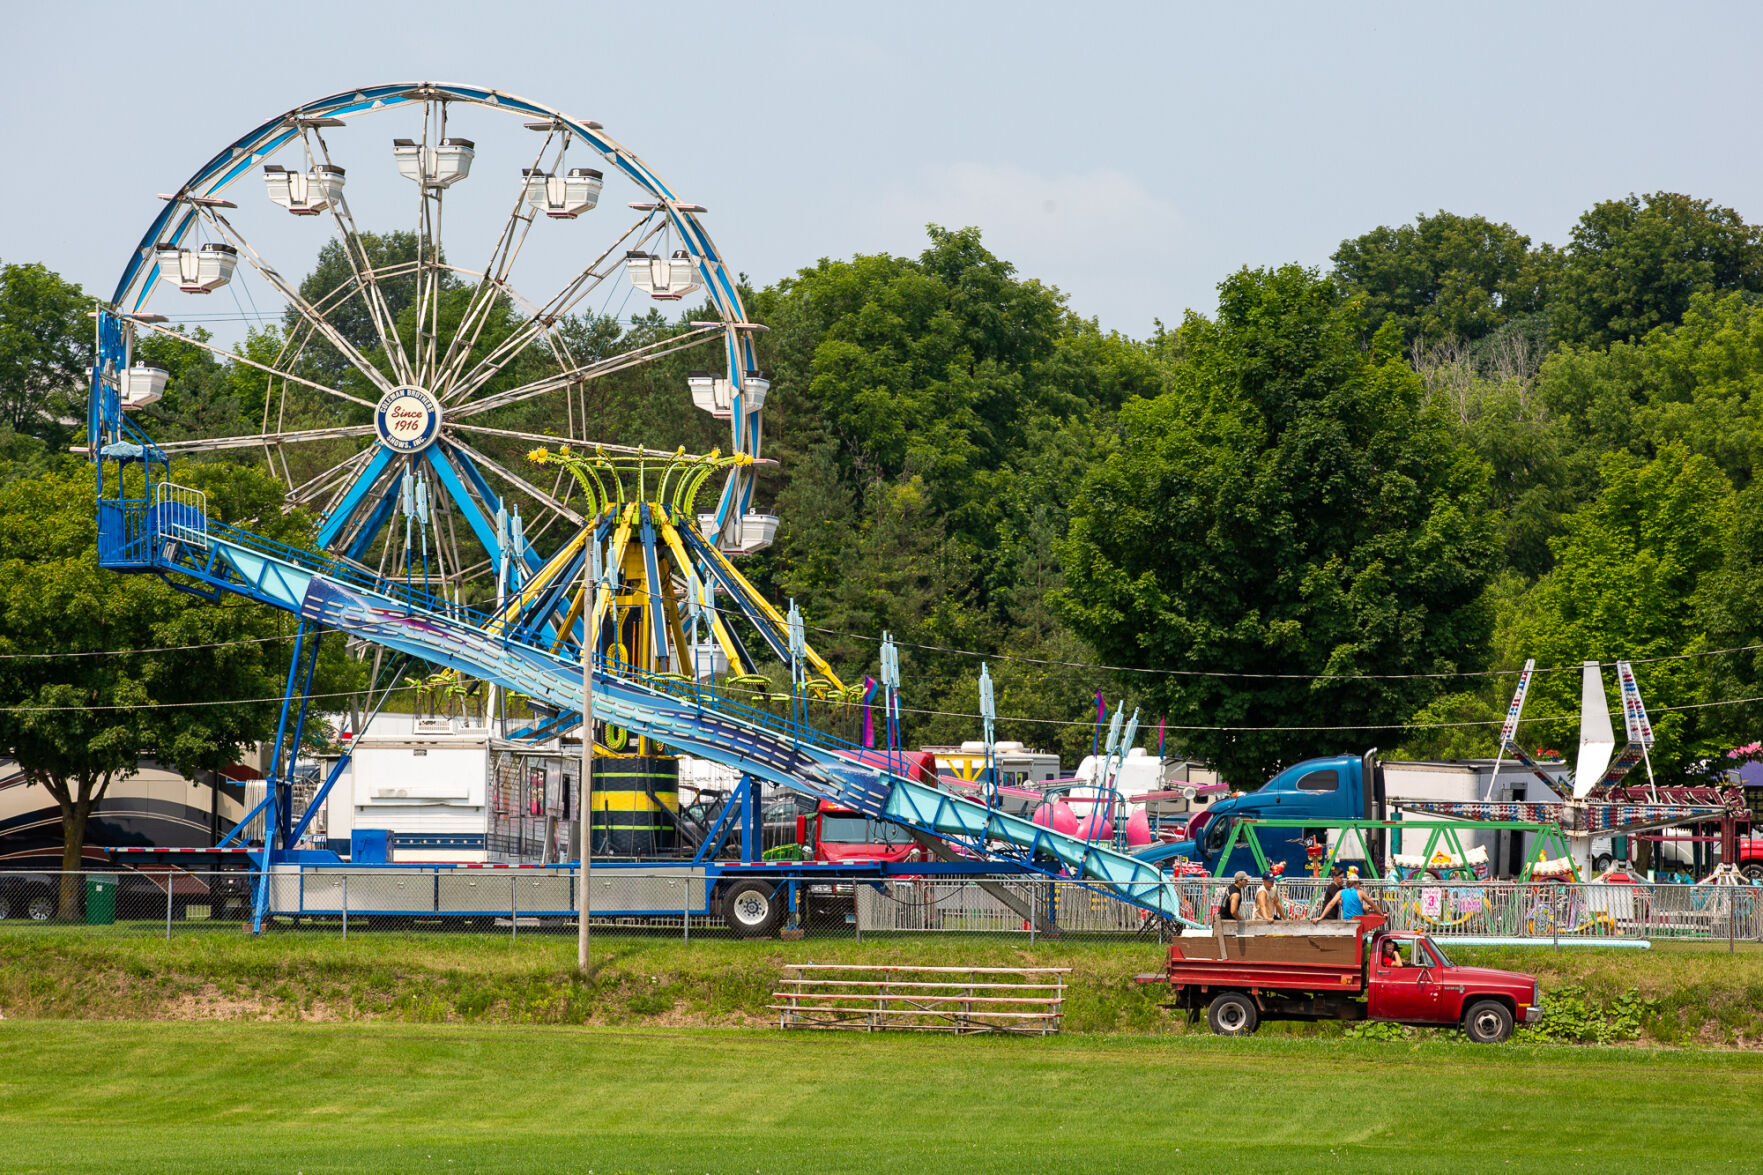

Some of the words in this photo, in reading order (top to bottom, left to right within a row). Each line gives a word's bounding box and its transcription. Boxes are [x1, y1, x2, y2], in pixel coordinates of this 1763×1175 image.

[135, 360, 145, 368] 12
[380, 389, 405, 414] COLEMAN
[407, 389, 435, 414] BROTHERS
[391, 406, 423, 418] Since
[394, 420, 419, 431] 1916
[412, 436, 427, 447] INC.
[1427, 895, 1435, 907] 3
